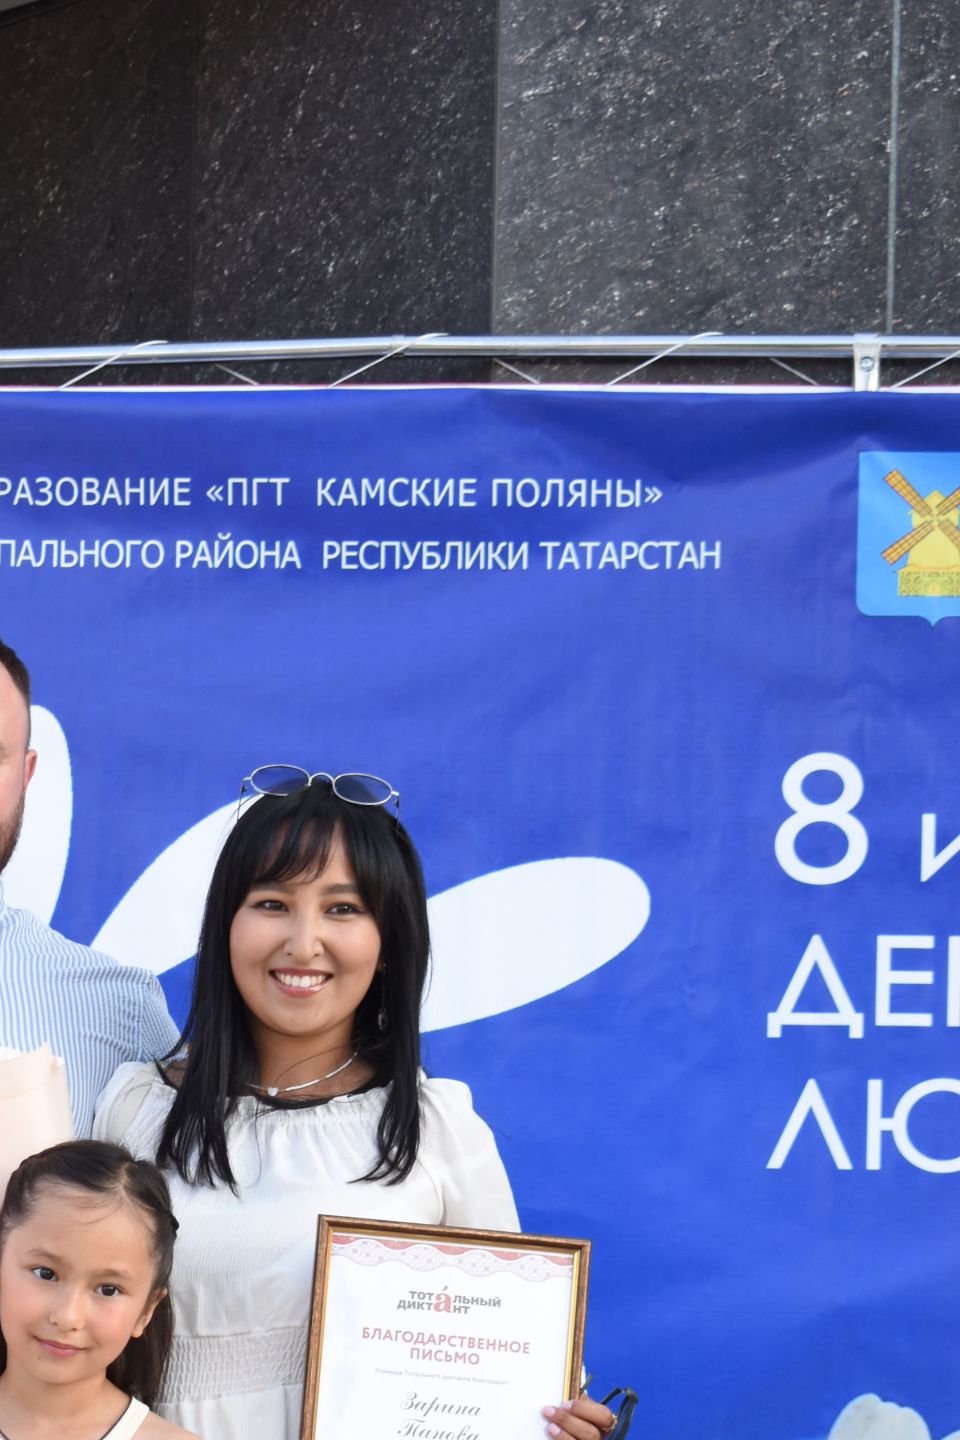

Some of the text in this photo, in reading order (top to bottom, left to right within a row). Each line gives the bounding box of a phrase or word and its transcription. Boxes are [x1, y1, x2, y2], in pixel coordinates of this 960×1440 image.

[206, 478, 290, 506] «ПГТ
[317, 477, 477, 507] КАМСКИЕ
[492, 478, 663, 508] ПОЛЯНЫ»
[175, 533, 301, 569] РАЙОНА
[323, 540, 528, 570] РЕСПУБЛИКИ
[539, 541, 721, 570] ТАТАРСТАН
[775, 752, 868, 885] 8
[767, 934, 960, 1039] ДЕ
[361, 1327, 531, 1354] БЛАГОДАРСТВЕННОЕ
[409, 1347, 480, 1365] ПИСЬМО
[400, 1391, 482, 1417] Зарина
